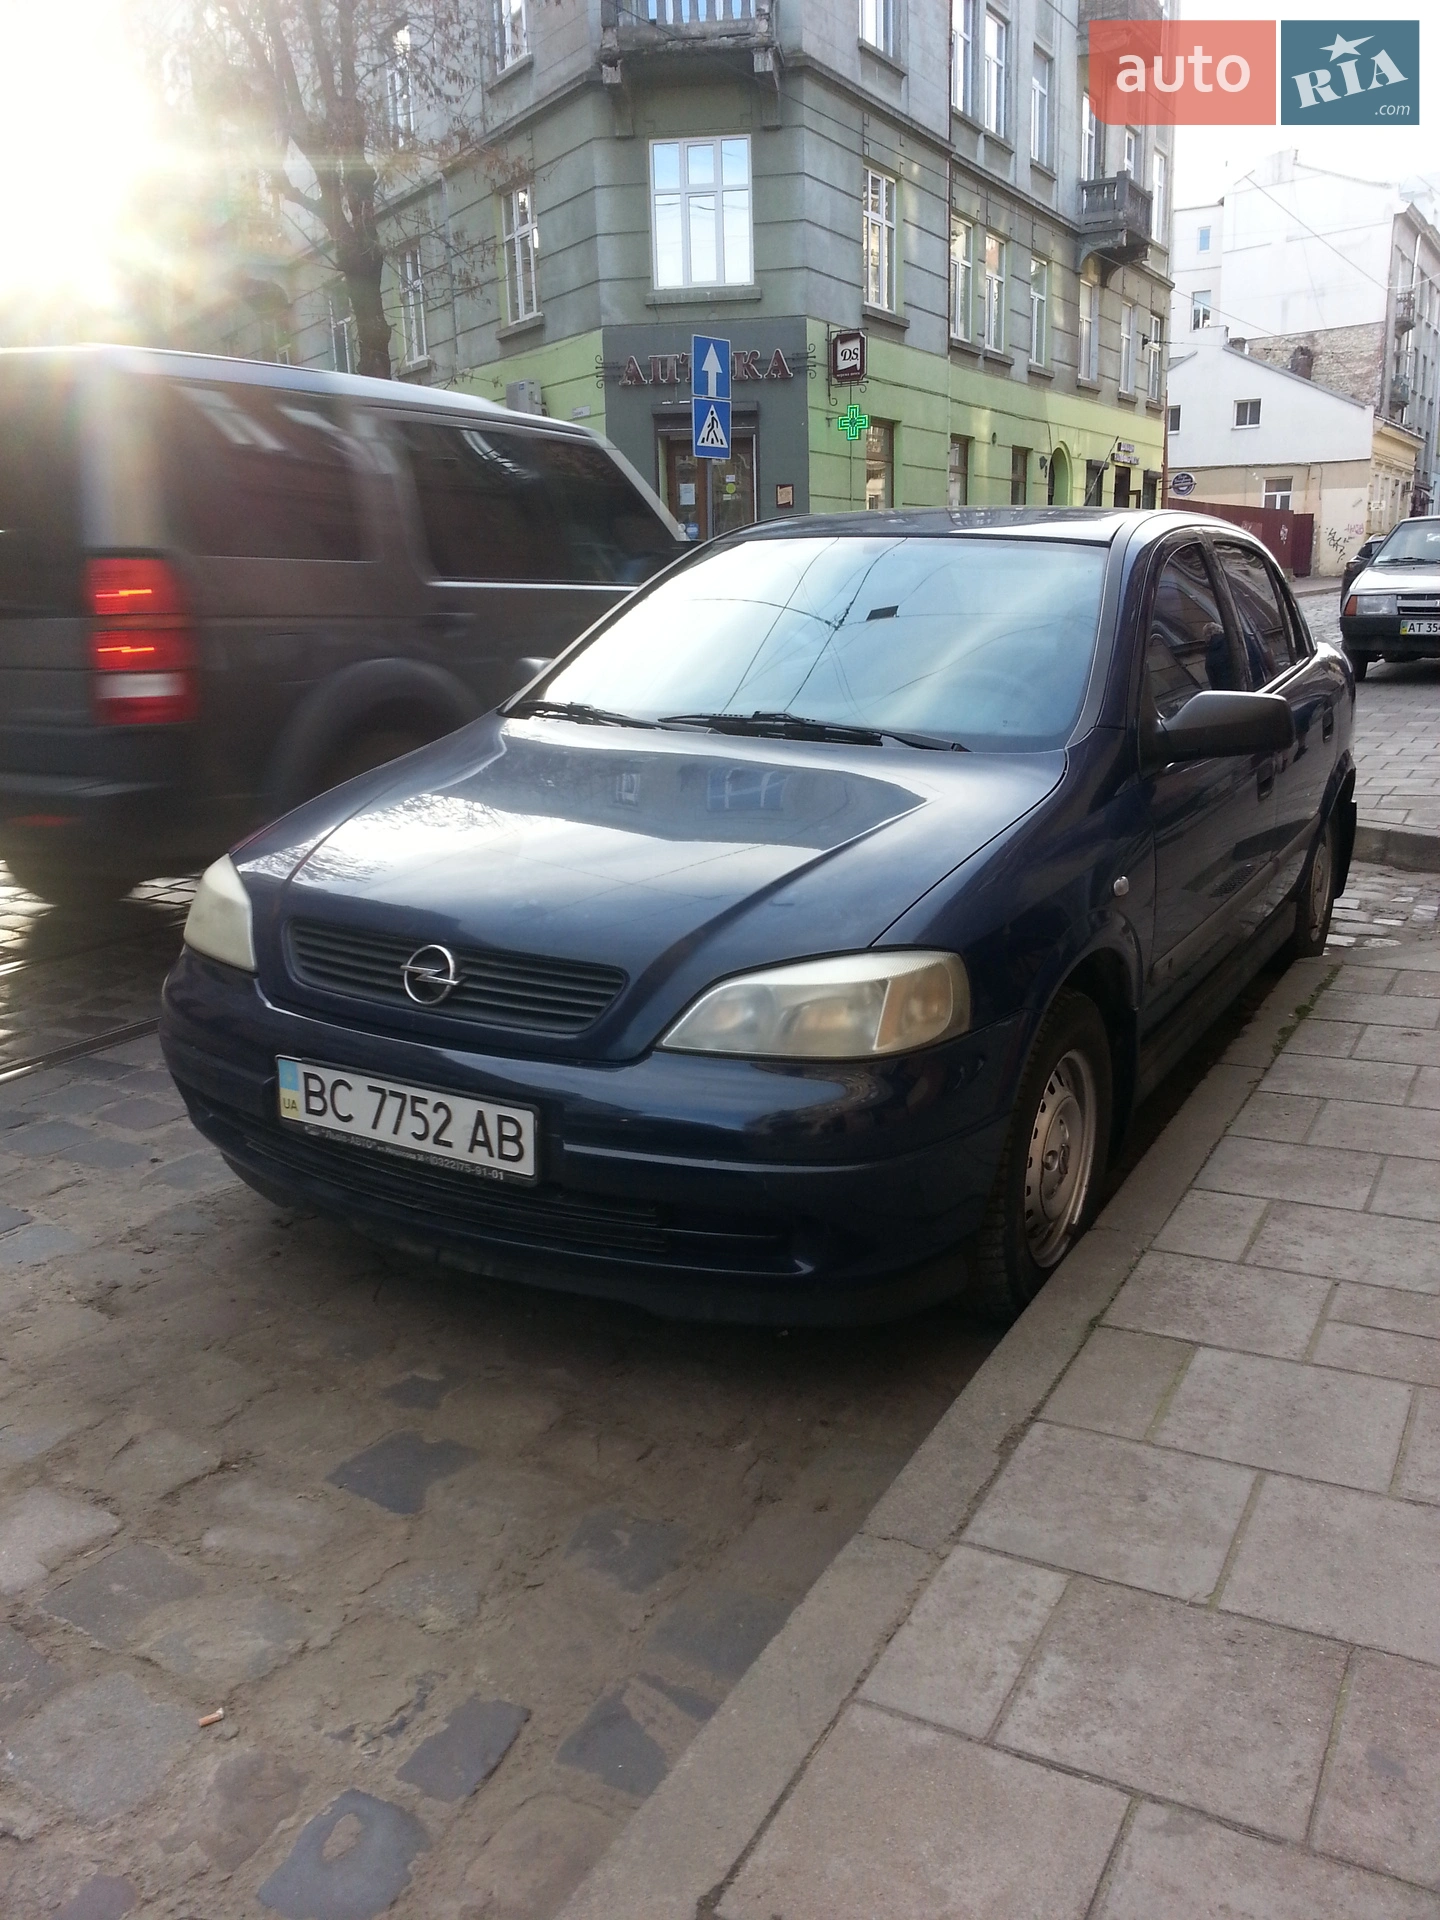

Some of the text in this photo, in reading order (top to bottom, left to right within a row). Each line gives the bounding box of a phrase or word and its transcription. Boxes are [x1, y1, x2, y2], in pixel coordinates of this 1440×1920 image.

[618, 348, 794, 387] АПТКА
[1407, 622, 1424, 633] AT
[283, 1097, 299, 1111] UA
[302, 1071, 525, 1163] BC 7752 AB
